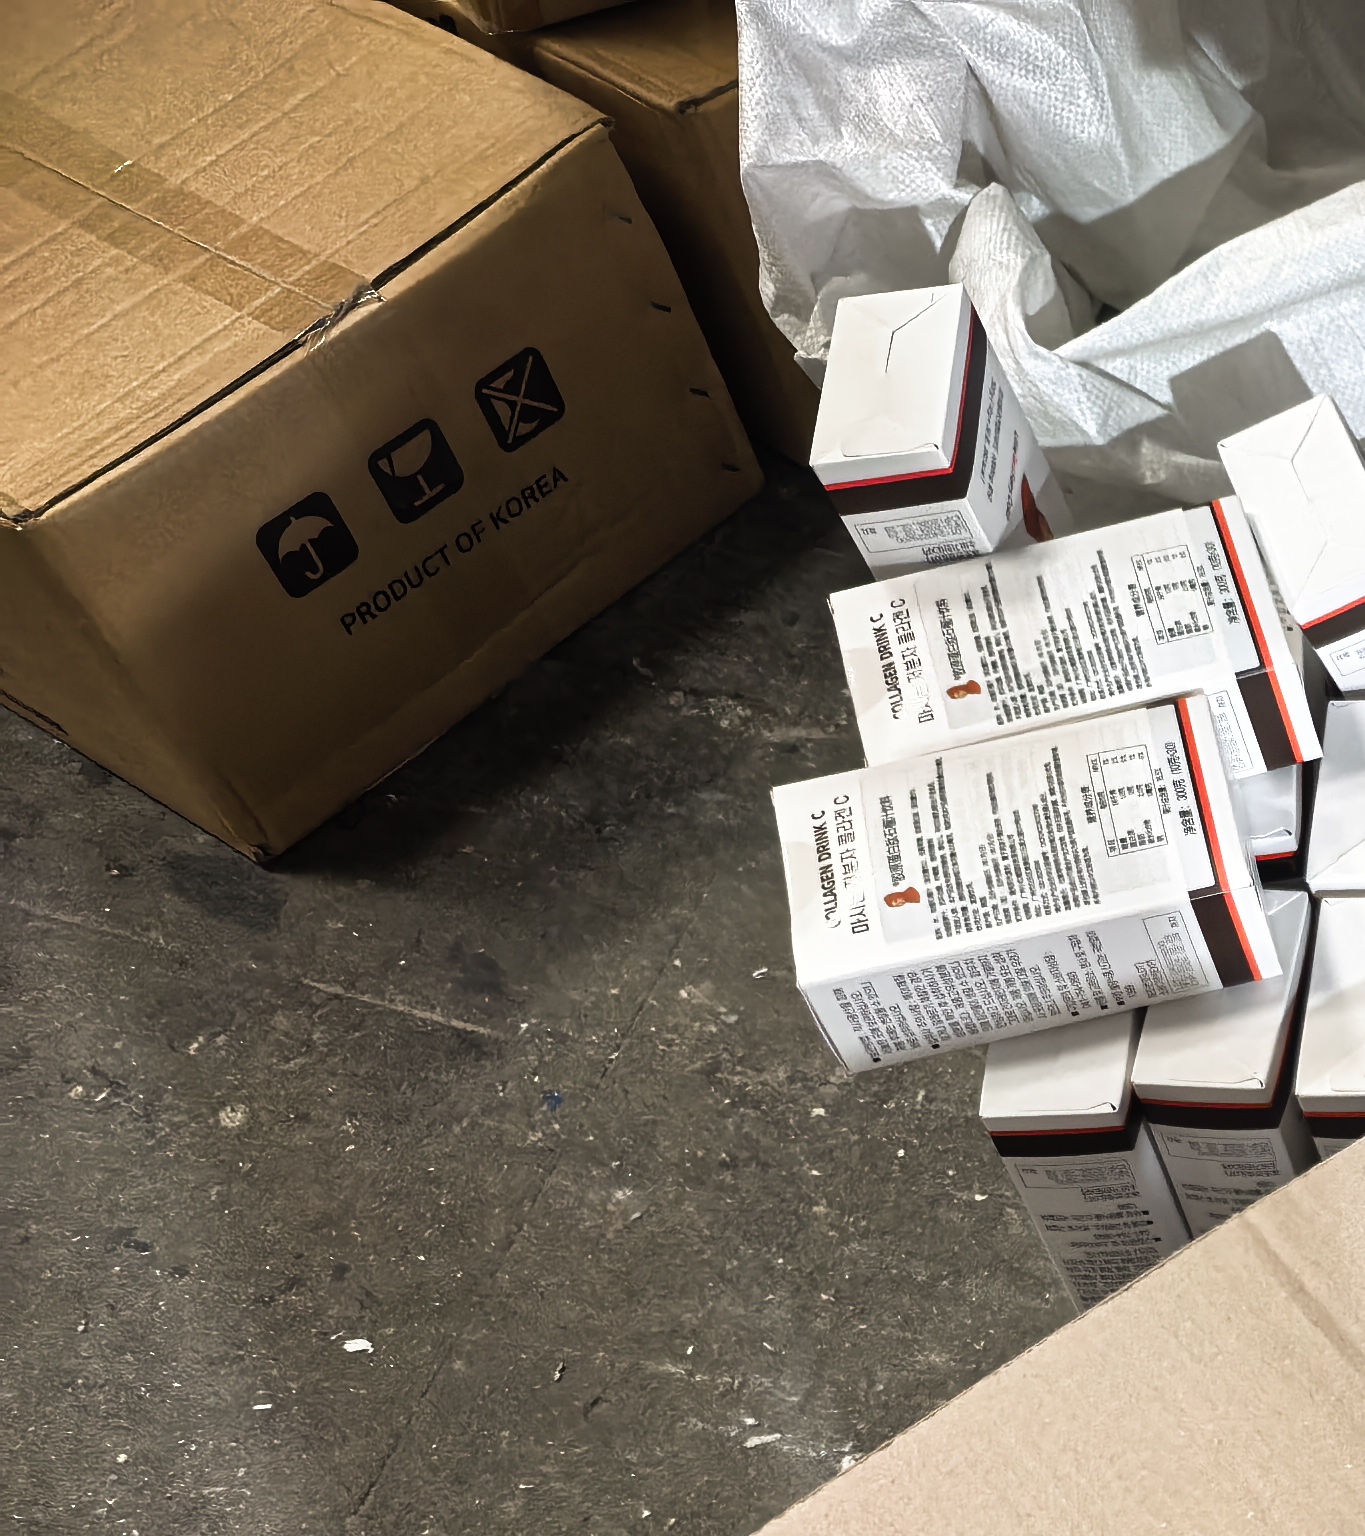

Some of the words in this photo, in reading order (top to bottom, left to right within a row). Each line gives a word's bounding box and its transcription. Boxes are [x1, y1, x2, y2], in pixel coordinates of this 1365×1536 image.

[340, 544, 452, 635] PRODUCT
[455, 520, 485, 553] OF
[489, 466, 569, 530] KOREA
[890, 598, 906, 609] C
[869, 612, 884, 623] C
[872, 622, 893, 662] DRINK
[833, 795, 850, 805] C
[811, 810, 825, 820] C
[834, 806, 855, 847] 콜라겐
[813, 821, 832, 863] DRINK
